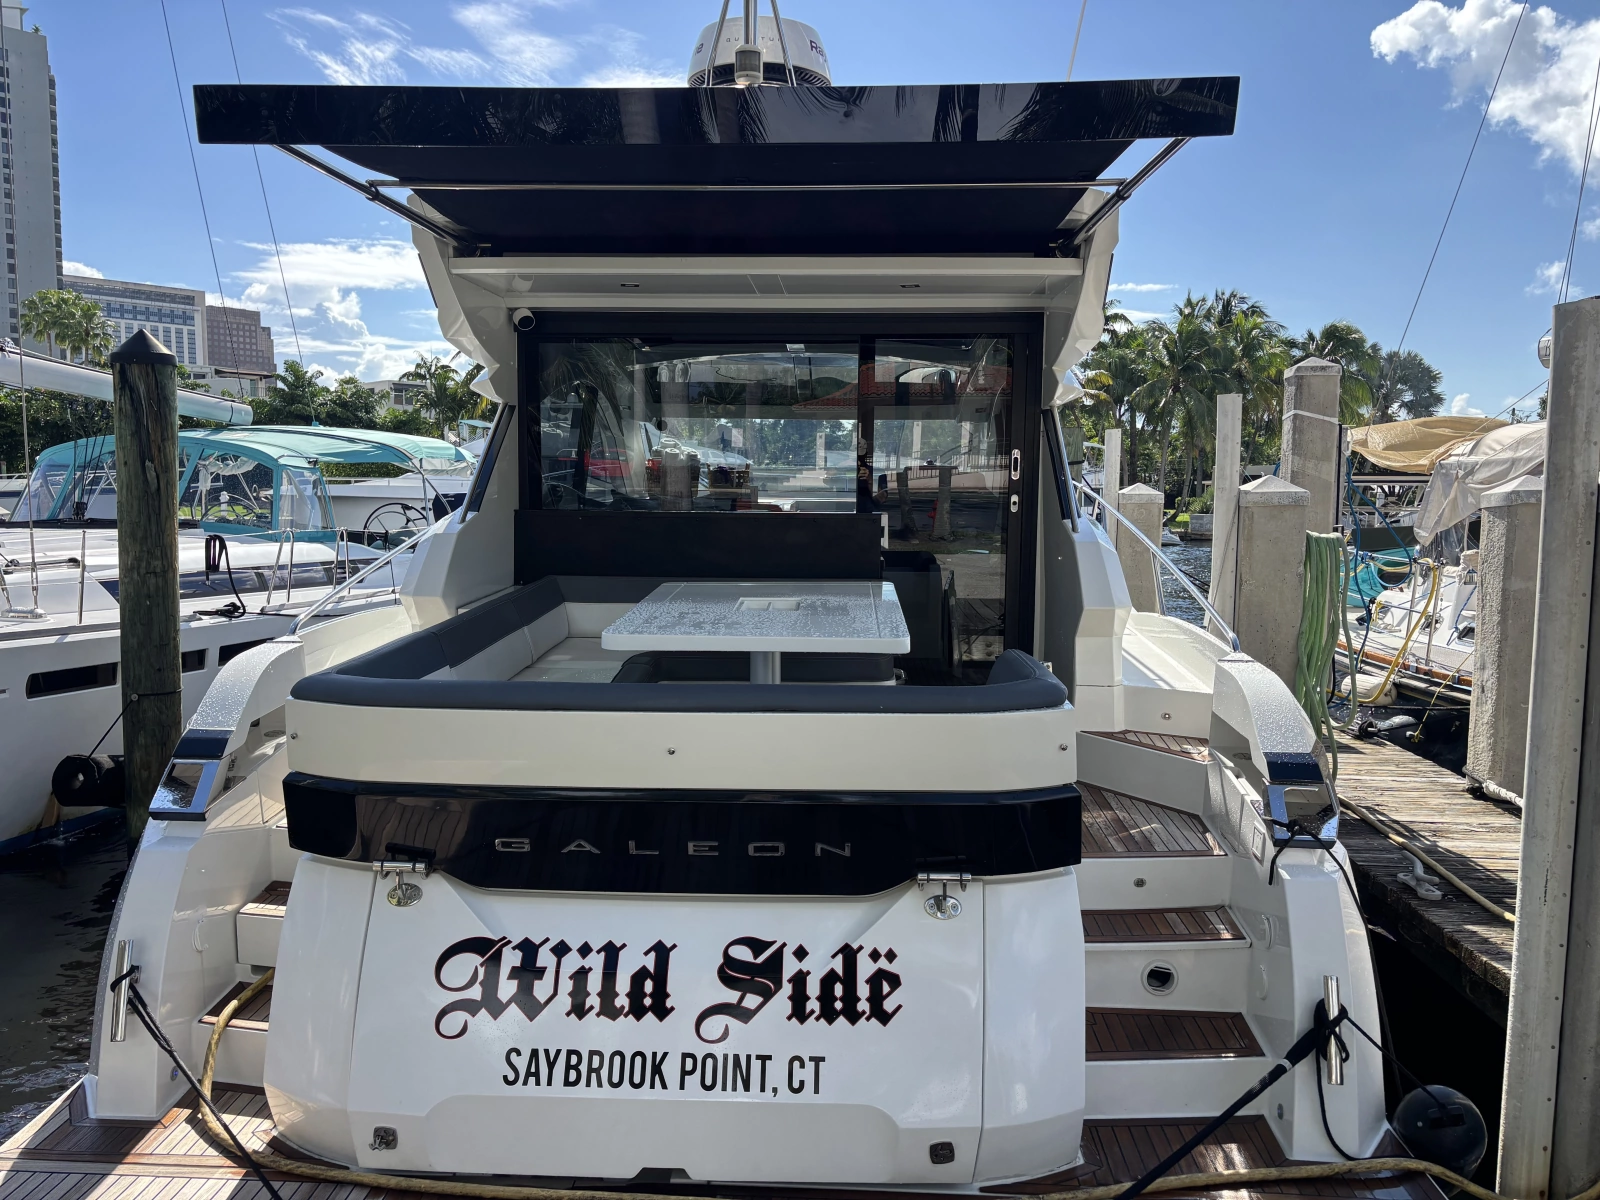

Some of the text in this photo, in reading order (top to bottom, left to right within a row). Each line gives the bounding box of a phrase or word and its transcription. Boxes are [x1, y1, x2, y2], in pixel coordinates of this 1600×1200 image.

[495, 838, 851, 857] GALEON
[434, 935, 678, 1040] Wild
[502, 1047, 826, 1098] SAYBROOK POINT, CT
